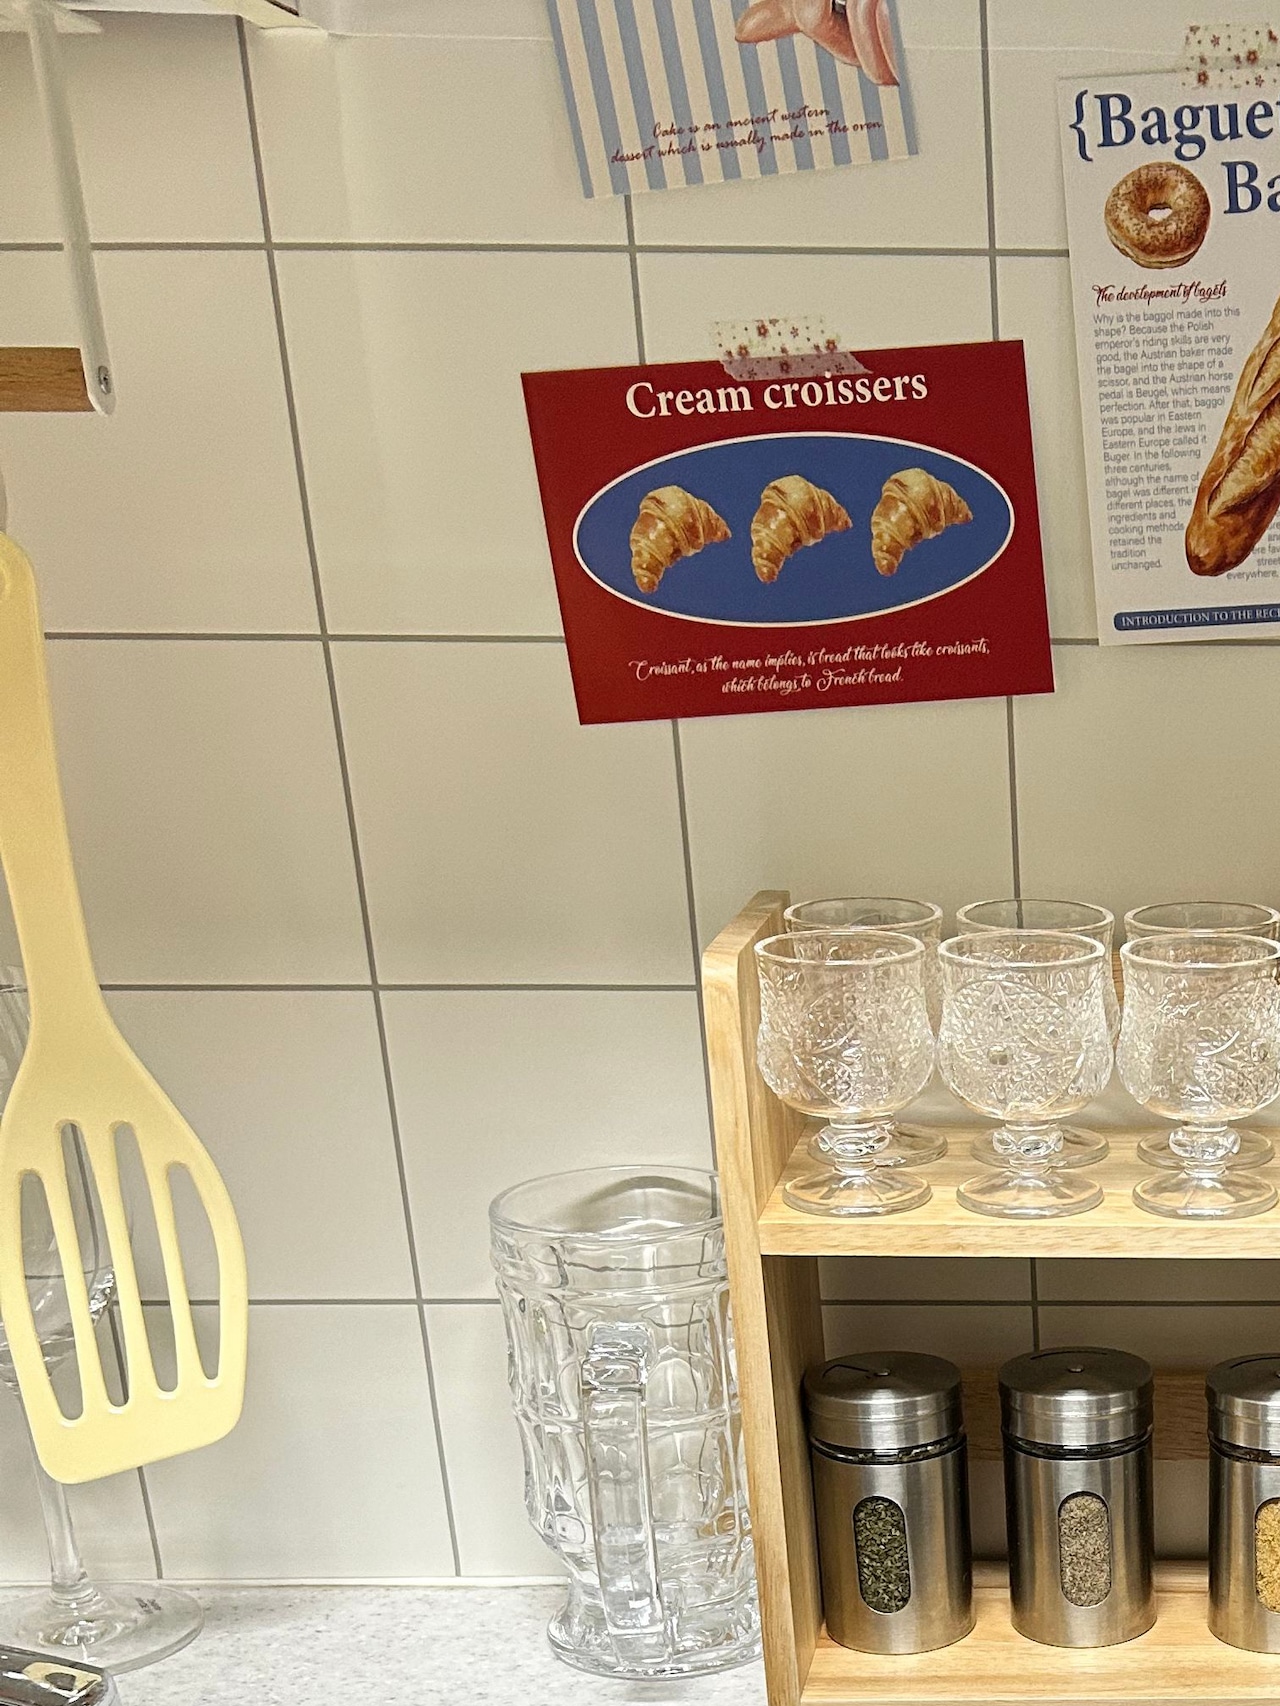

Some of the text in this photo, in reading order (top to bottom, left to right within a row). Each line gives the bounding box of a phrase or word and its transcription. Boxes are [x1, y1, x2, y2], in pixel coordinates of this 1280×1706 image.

[653, 105, 830, 139] Cake is an ancient western
[611, 145, 655, 163] dessert
[658, 138, 697, 157] which
[701, 142, 712, 151] is
[717, 130, 765, 153] usually
[770, 125, 805, 141] made
[808, 129, 824, 137] in
[826, 120, 849, 134] the
[1091, 284, 1115, 308] The
[1116, 283, 1181, 307] development
[1194, 280, 1227, 304] bagels
[1093, 312, 1113, 326] Why
[1116, 314, 1124, 323] is
[1126, 312, 1140, 322] the
[1177, 308, 1202, 320] made
[1204, 307, 1222, 319] into
[1224, 305, 1240, 317] this
[625, 371, 928, 419] Cream croissers
[1121, 612, 1210, 628] INTRODUCTION
[1212, 611, 1229, 622] TO
[1229, 609, 1253, 621] THE
[695, 661, 708, 673] as
[705, 655, 729, 671] the
[732, 658, 762, 670] name
[807, 650, 818, 665] is
[819, 647, 851, 664] bread
[851, 643, 880, 661] that
[880, 642, 908, 660] looks
[908, 641, 933, 657] like
[721, 675, 755, 693] which
[756, 673, 802, 696] belongs
[797, 673, 812, 688] to
[816, 667, 866, 692] French
